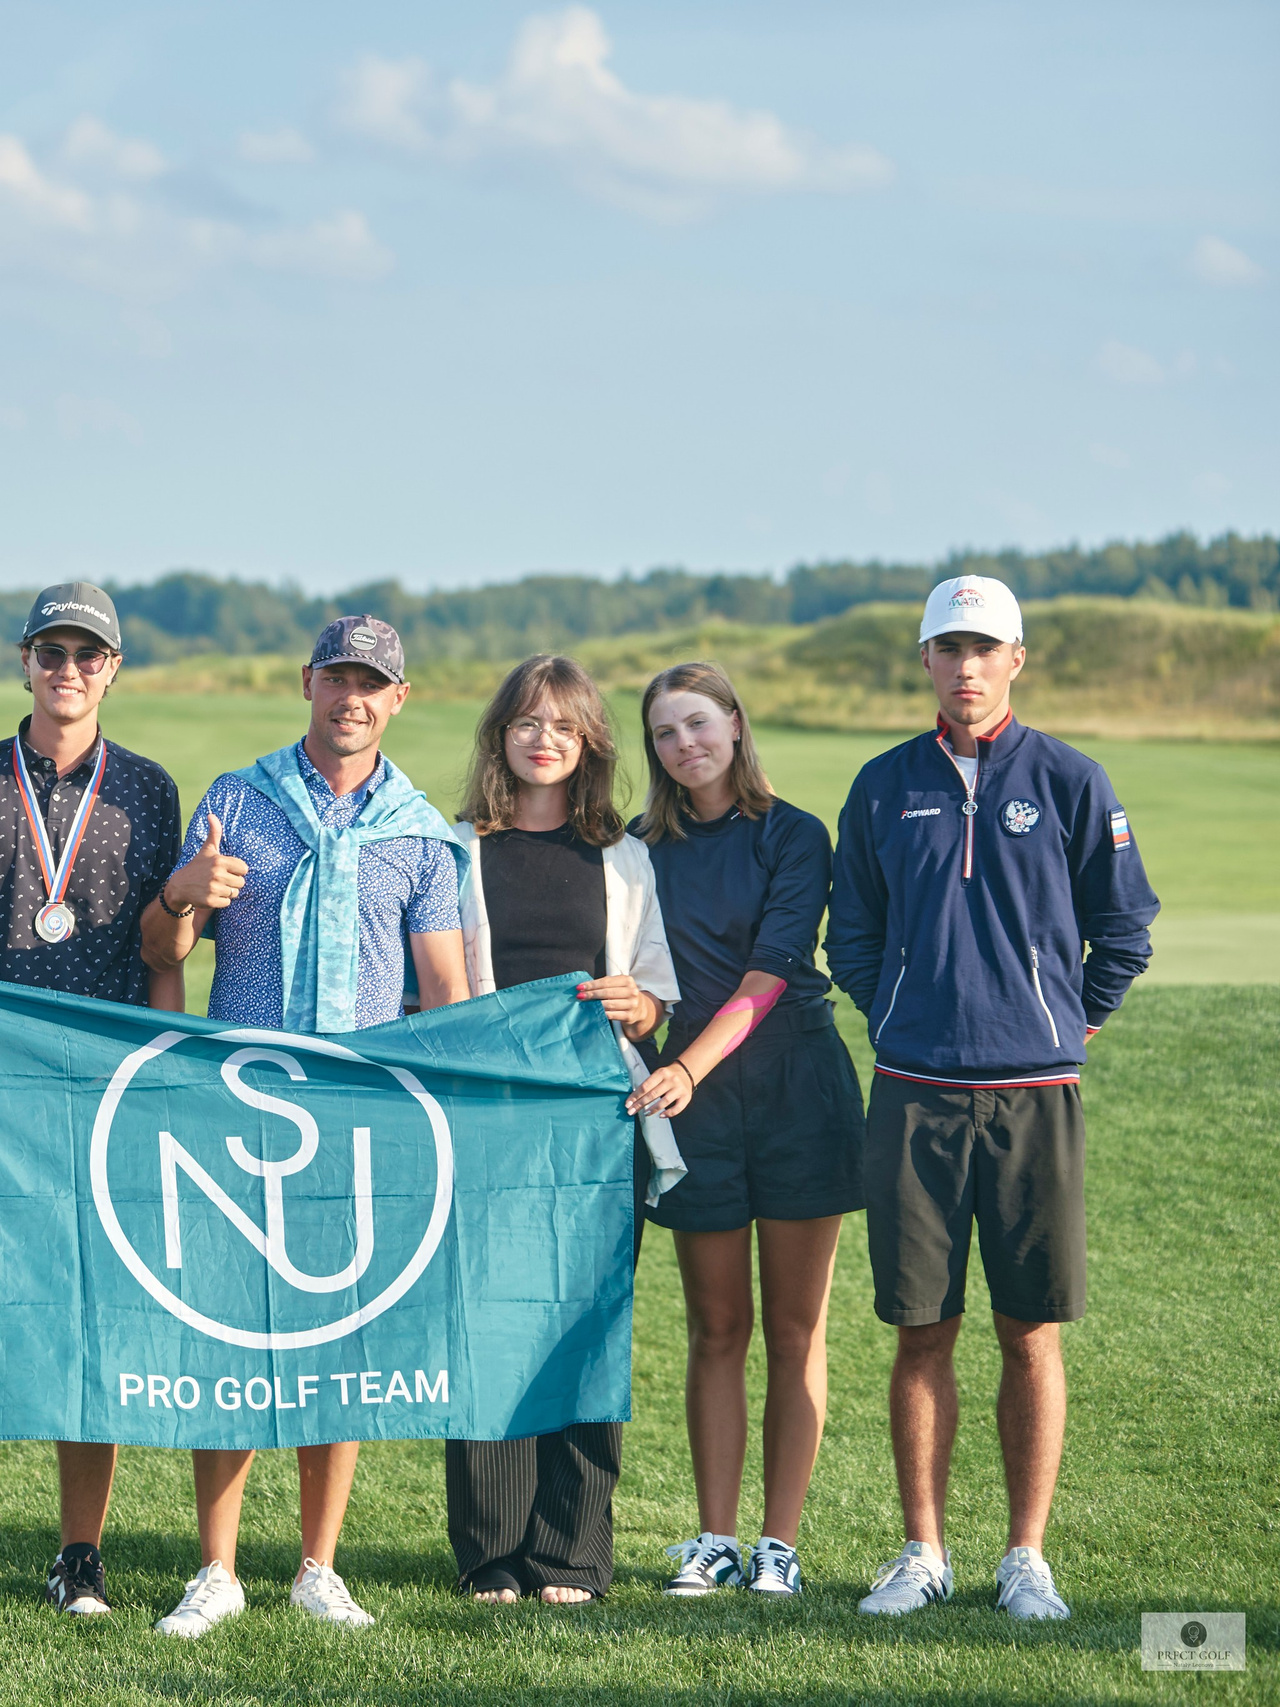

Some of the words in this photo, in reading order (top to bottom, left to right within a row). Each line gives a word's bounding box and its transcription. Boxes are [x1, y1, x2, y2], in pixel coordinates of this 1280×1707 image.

[41, 601, 111, 625] TaylorMade
[901, 808, 941, 819] FORWARD
[120, 1372, 200, 1410] PRO
[214, 1375, 319, 1411] GOLF
[330, 1369, 450, 1404] TEAM
